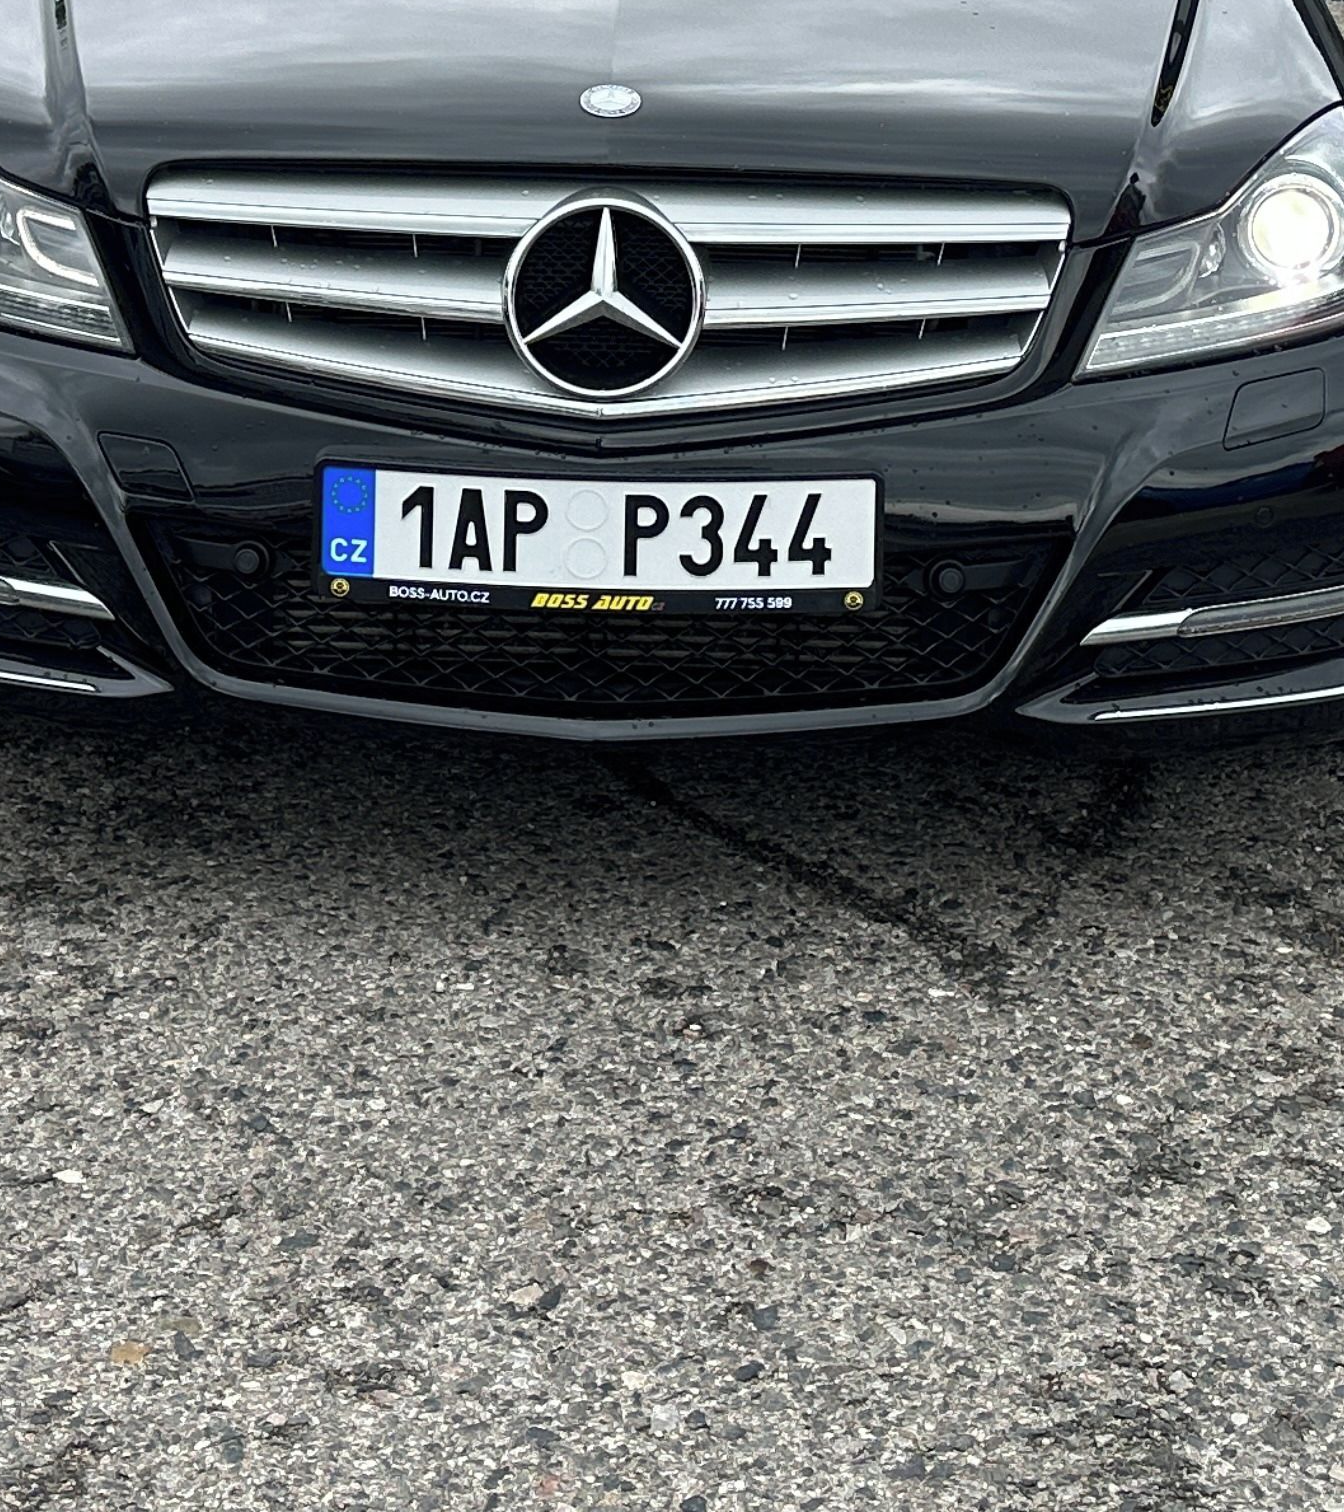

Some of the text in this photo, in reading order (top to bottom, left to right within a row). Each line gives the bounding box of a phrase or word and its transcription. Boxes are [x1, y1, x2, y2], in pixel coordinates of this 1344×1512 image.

[401, 486, 832, 577] 1AP P344
[330, 537, 368, 563] CZ
[389, 585, 491, 604] BOSS-AUTO.CZ
[530, 593, 589, 608] BOSS
[591, 595, 654, 611] AUTO
[715, 597, 793, 610] 777 755 599
